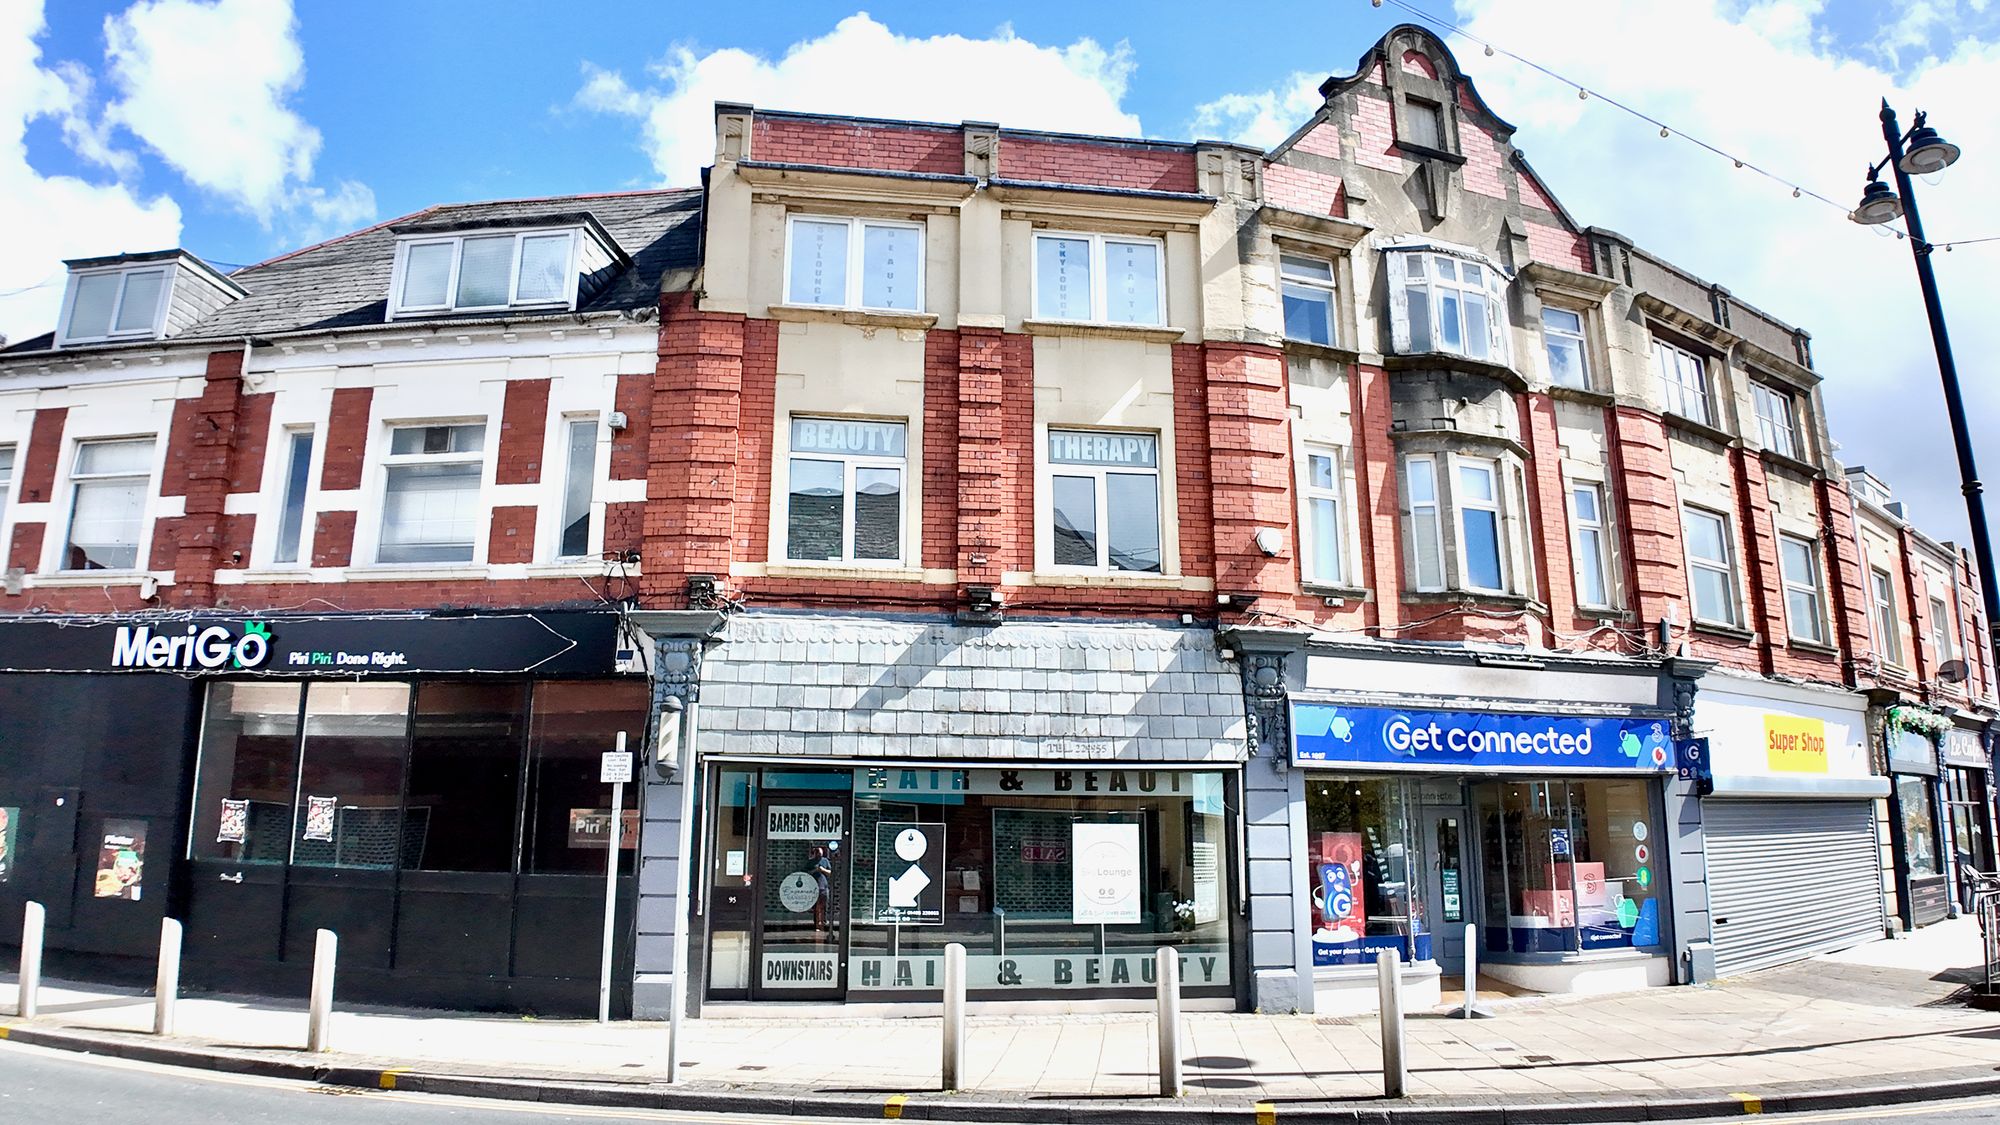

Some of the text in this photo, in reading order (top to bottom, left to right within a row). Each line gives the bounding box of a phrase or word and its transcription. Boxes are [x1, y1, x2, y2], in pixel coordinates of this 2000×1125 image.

[799, 423, 896, 452] BEAUTY
[1050, 435, 1153, 463] THERAPY
[289, 651, 407, 668] Piri Piri. Done Right.
[1388, 721, 1592, 755] Get connected
[1769, 729, 1825, 755] Super Shop
[999, 770, 1024, 791] &
[575, 819, 600, 833] Piri
[769, 812, 841, 833] BARBER SHOP
[728, 896, 737, 904] 95
[766, 960, 833, 981] DOWNSTAIRS
[861, 959, 935, 986] HAI
[997, 959, 1022, 986] &
